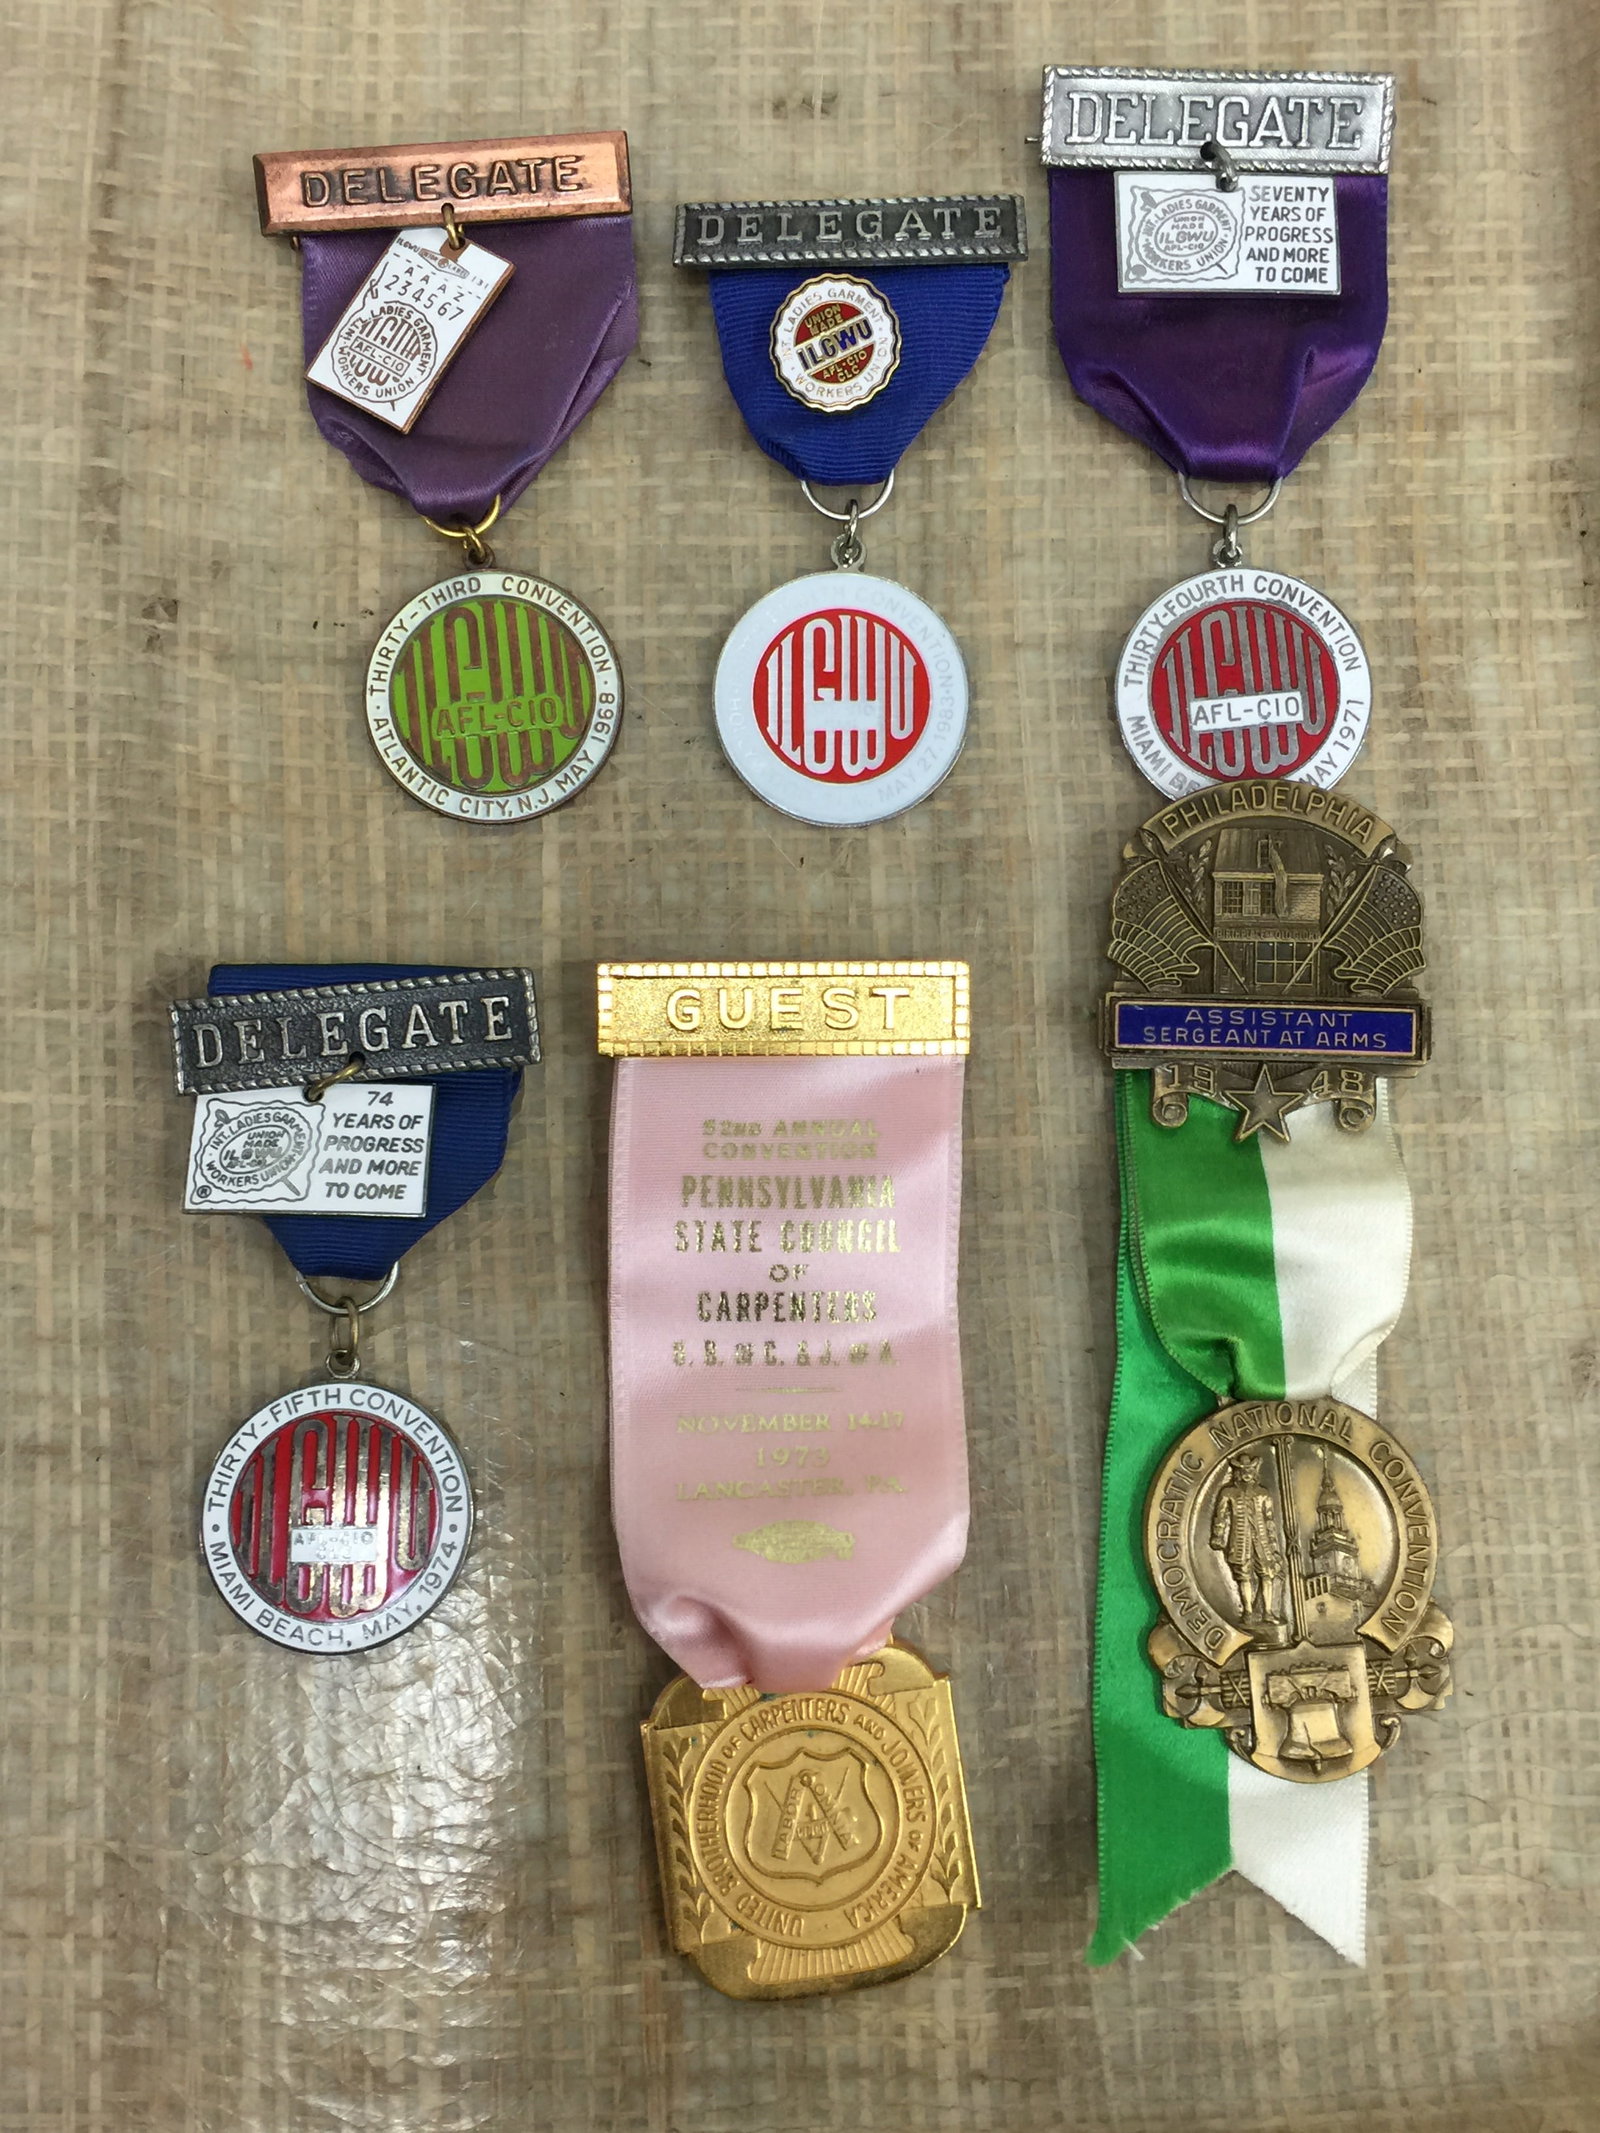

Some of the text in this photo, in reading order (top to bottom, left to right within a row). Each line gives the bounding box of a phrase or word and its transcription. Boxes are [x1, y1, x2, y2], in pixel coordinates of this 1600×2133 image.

[1065, 90, 1363, 150] DELEGATE
[301, 154, 583, 207] DELEGATE
[1249, 185, 1329, 202] SEVENTY
[697, 206, 1001, 246] DELEGATE
[1154, 199, 1193, 221] LADIES
[1195, 200, 1232, 232] GARMENT
[1249, 206, 1327, 222] YEARS OF
[1244, 227, 1333, 244] PROGRESS
[1196, 238, 1228, 267] UNION
[1246, 248, 1330, 263] AND MORE
[1255, 267, 1328, 284] TO COME
[784, 292, 822, 332] LADIES
[828, 288, 884, 323] GARMENT
[804, 304, 841, 328] UNION
[809, 313, 843, 336] MADE
[354, 341, 404, 371] AFL-CIO
[370, 305, 414, 319] LADIES
[413, 318, 432, 375] GARMENT
[796, 316, 874, 371] ILGWU
[338, 345, 415, 398] WORKERS UNION
[796, 337, 888, 398] WORKERS UNION
[837, 364, 860, 383] CLC
[369, 577, 482, 696] THIRTY-THIRD
[501, 576, 611, 672] CONVENTION
[856, 586, 954, 688] CONVENTION
[1124, 575, 1362, 687] THIRTY-FOURTH CONVENTION
[437, 698, 558, 736] AFL-CIO
[934, 695, 955, 741] 1983
[1193, 696, 1300, 726] AFL-CIO
[1126, 715, 1173, 778] MIAMI
[1332, 699, 1364, 751] 1971
[374, 717, 450, 806] ATLANTIC
[459, 797, 513, 818] CITY,
[558, 750, 595, 793] MAY
[591, 692, 615, 743] 1968
[878, 770, 916, 802] MAY
[1162, 786, 1374, 844] PHILADELPHIA
[666, 987, 911, 1031] GUEST
[1185, 1010, 1353, 1026] ASSISTANT
[193, 996, 513, 1069] DELEGATE
[1143, 1027, 1387, 1048] SERGEANT AT ARMS
[367, 1091, 394, 1107] 74
[228, 1112, 271, 1135] LADIES
[247, 1130, 286, 1140] UNION
[332, 1112, 424, 1130] YEARS OF
[773, 1119, 881, 1138] ANNUAL
[243, 1139, 280, 1149] MADE
[323, 1135, 425, 1153] PROGRESS
[703, 1142, 877, 1160] CONVENTION
[206, 1160, 260, 1187] WORKERS
[318, 1159, 422, 1176] AND MORE
[324, 1182, 407, 1200] TO COME
[681, 1175, 895, 1209] PENNSYLVANIA
[675, 1219, 900, 1253] STATE COUNCIL
[769, 1264, 809, 1282] OF
[697, 1291, 877, 1323] CARPENTERS
[676, 1413, 831, 1433] NOVEMBER
[207, 1388, 463, 1513] THIRTY-FIFTH CONVENTION
[1156, 1402, 1431, 1651] DEMOCRATIC NATIONAL CONVENTION
[209, 1541, 458, 1647] MIAMI BEACH, MAY, 1974
[697, 1698, 927, 1938] UNITED BROTHERHOOD OF CARPENTERS AND JOINERS OF AMERICA
